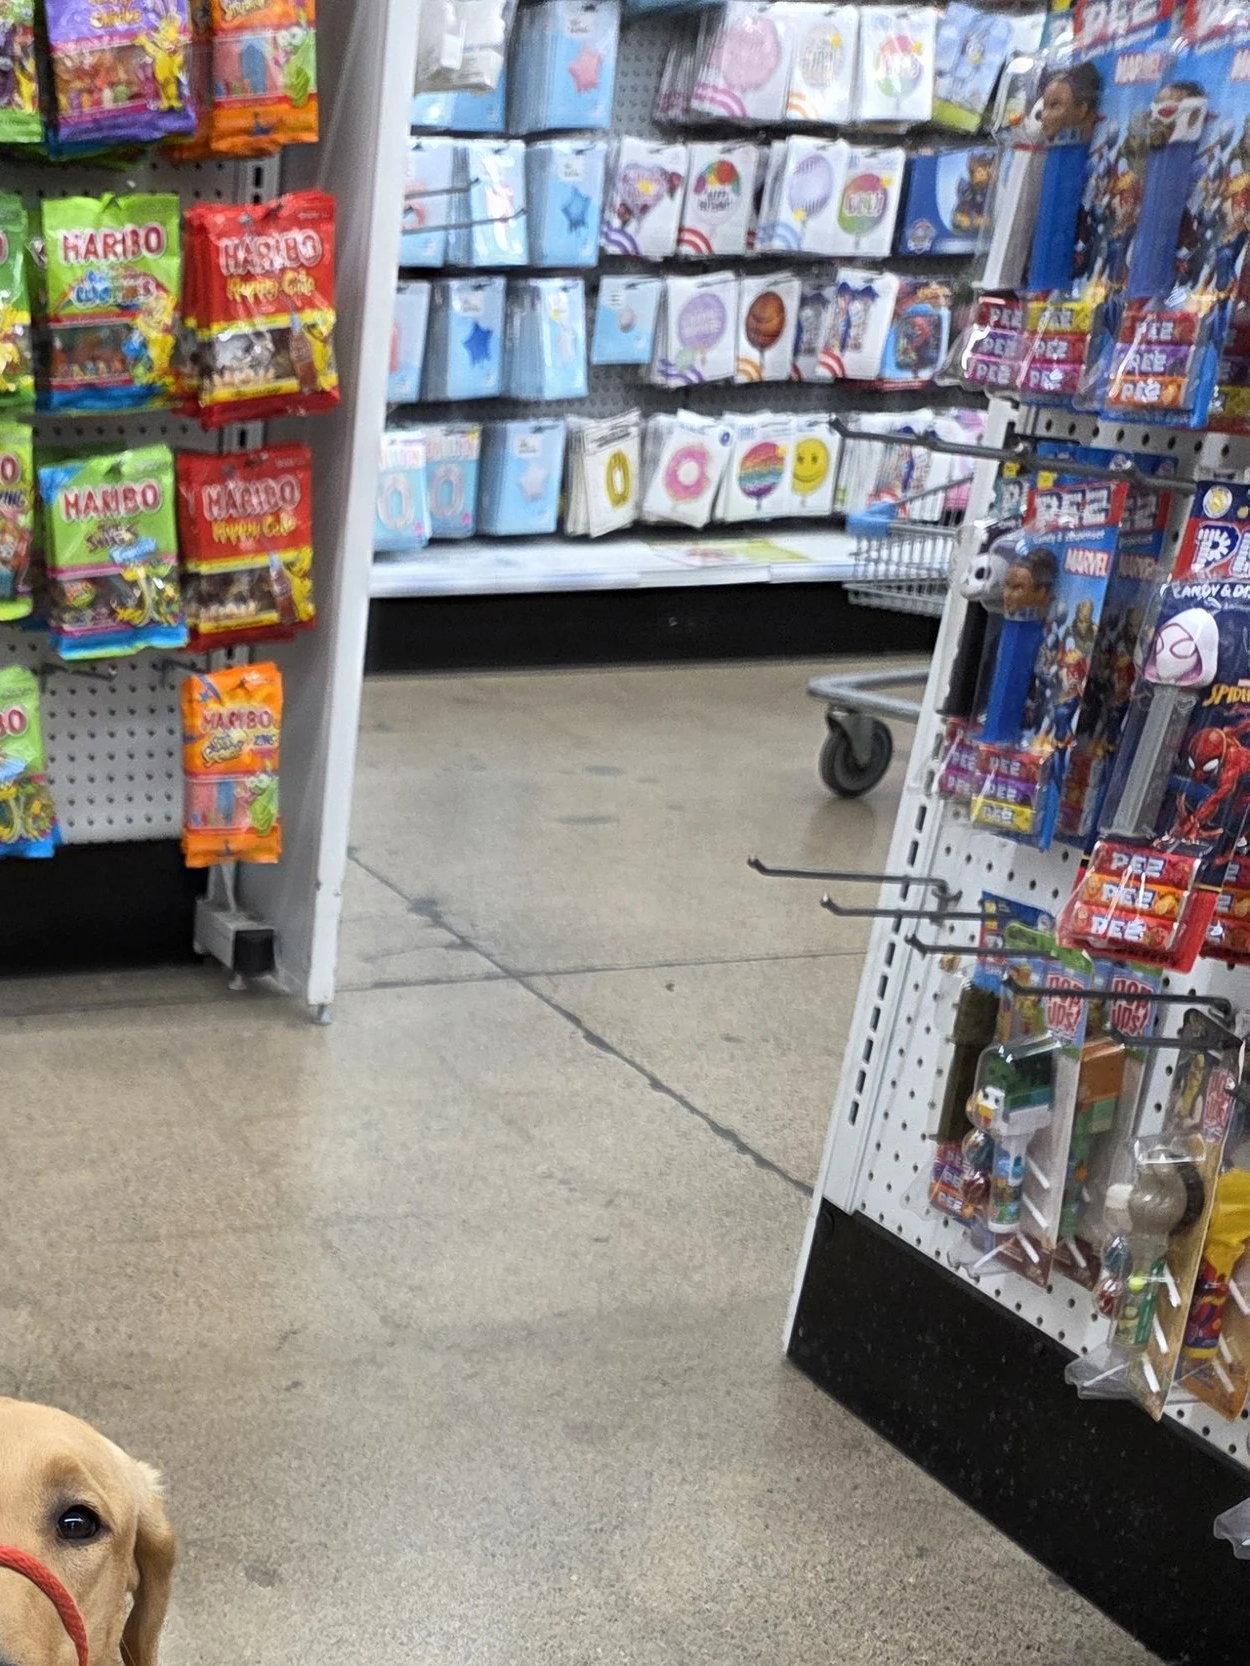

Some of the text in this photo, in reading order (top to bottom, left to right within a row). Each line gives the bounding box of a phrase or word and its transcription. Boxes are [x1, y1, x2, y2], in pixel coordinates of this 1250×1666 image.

[61, 225, 163, 262] HARIBO
[220, 231, 322, 275] HARIBO
[62, 482, 160, 521] HARIBO
[1034, 487, 1111, 531] PEZ
[1064, 547, 1109, 577] MARVEL
[1170, 583, 1220, 599] CANDY
[203, 709, 273, 731] HARIBO
[1110, 850, 1167, 878] PEZ
[1101, 881, 1156, 910] PEZ
[1091, 914, 1147, 942] PEZ
